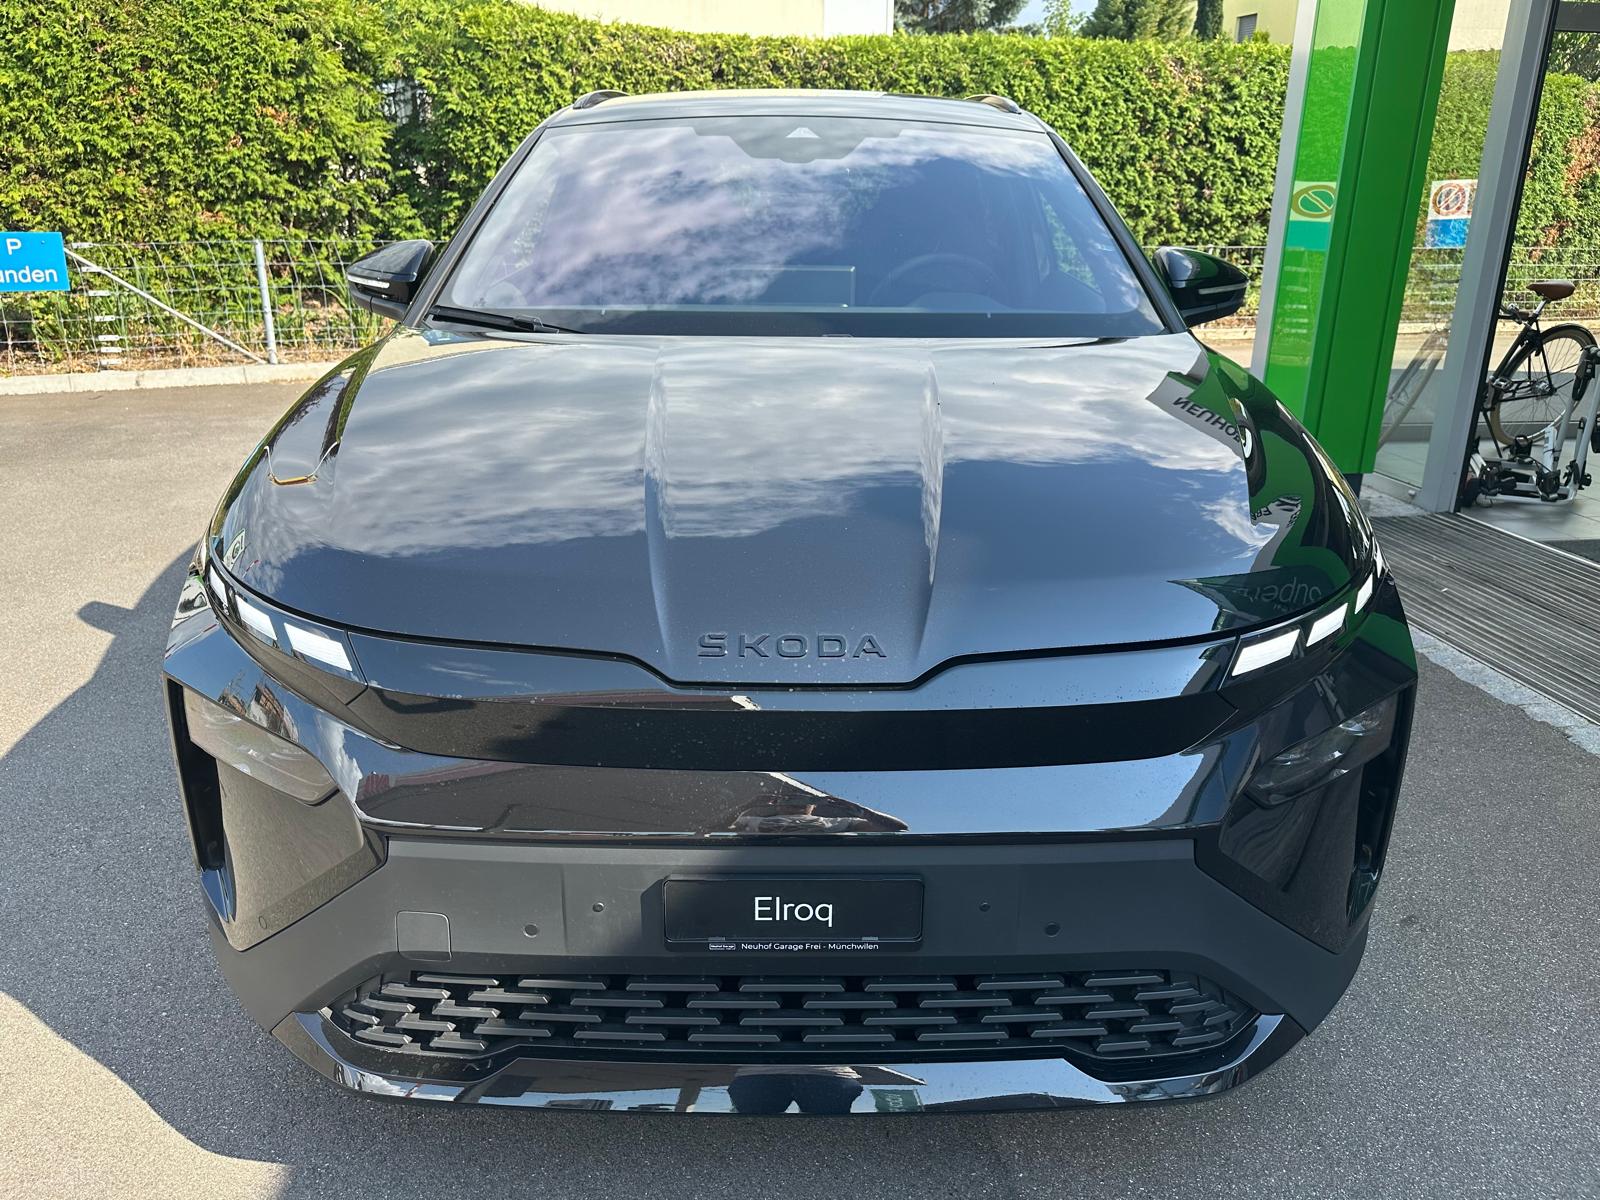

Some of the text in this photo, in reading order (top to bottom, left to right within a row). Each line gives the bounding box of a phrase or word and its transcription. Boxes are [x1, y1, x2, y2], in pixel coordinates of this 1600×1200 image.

[5, 238, 22, 256] P
[697, 632, 888, 658] SKODA
[754, 896, 833, 928] Elroq
[741, 942, 772, 951] Neuhof
[773, 942, 804, 952] Garage
[805, 942, 821, 951] Frei
[828, 942, 879, 951] Münchwilen
